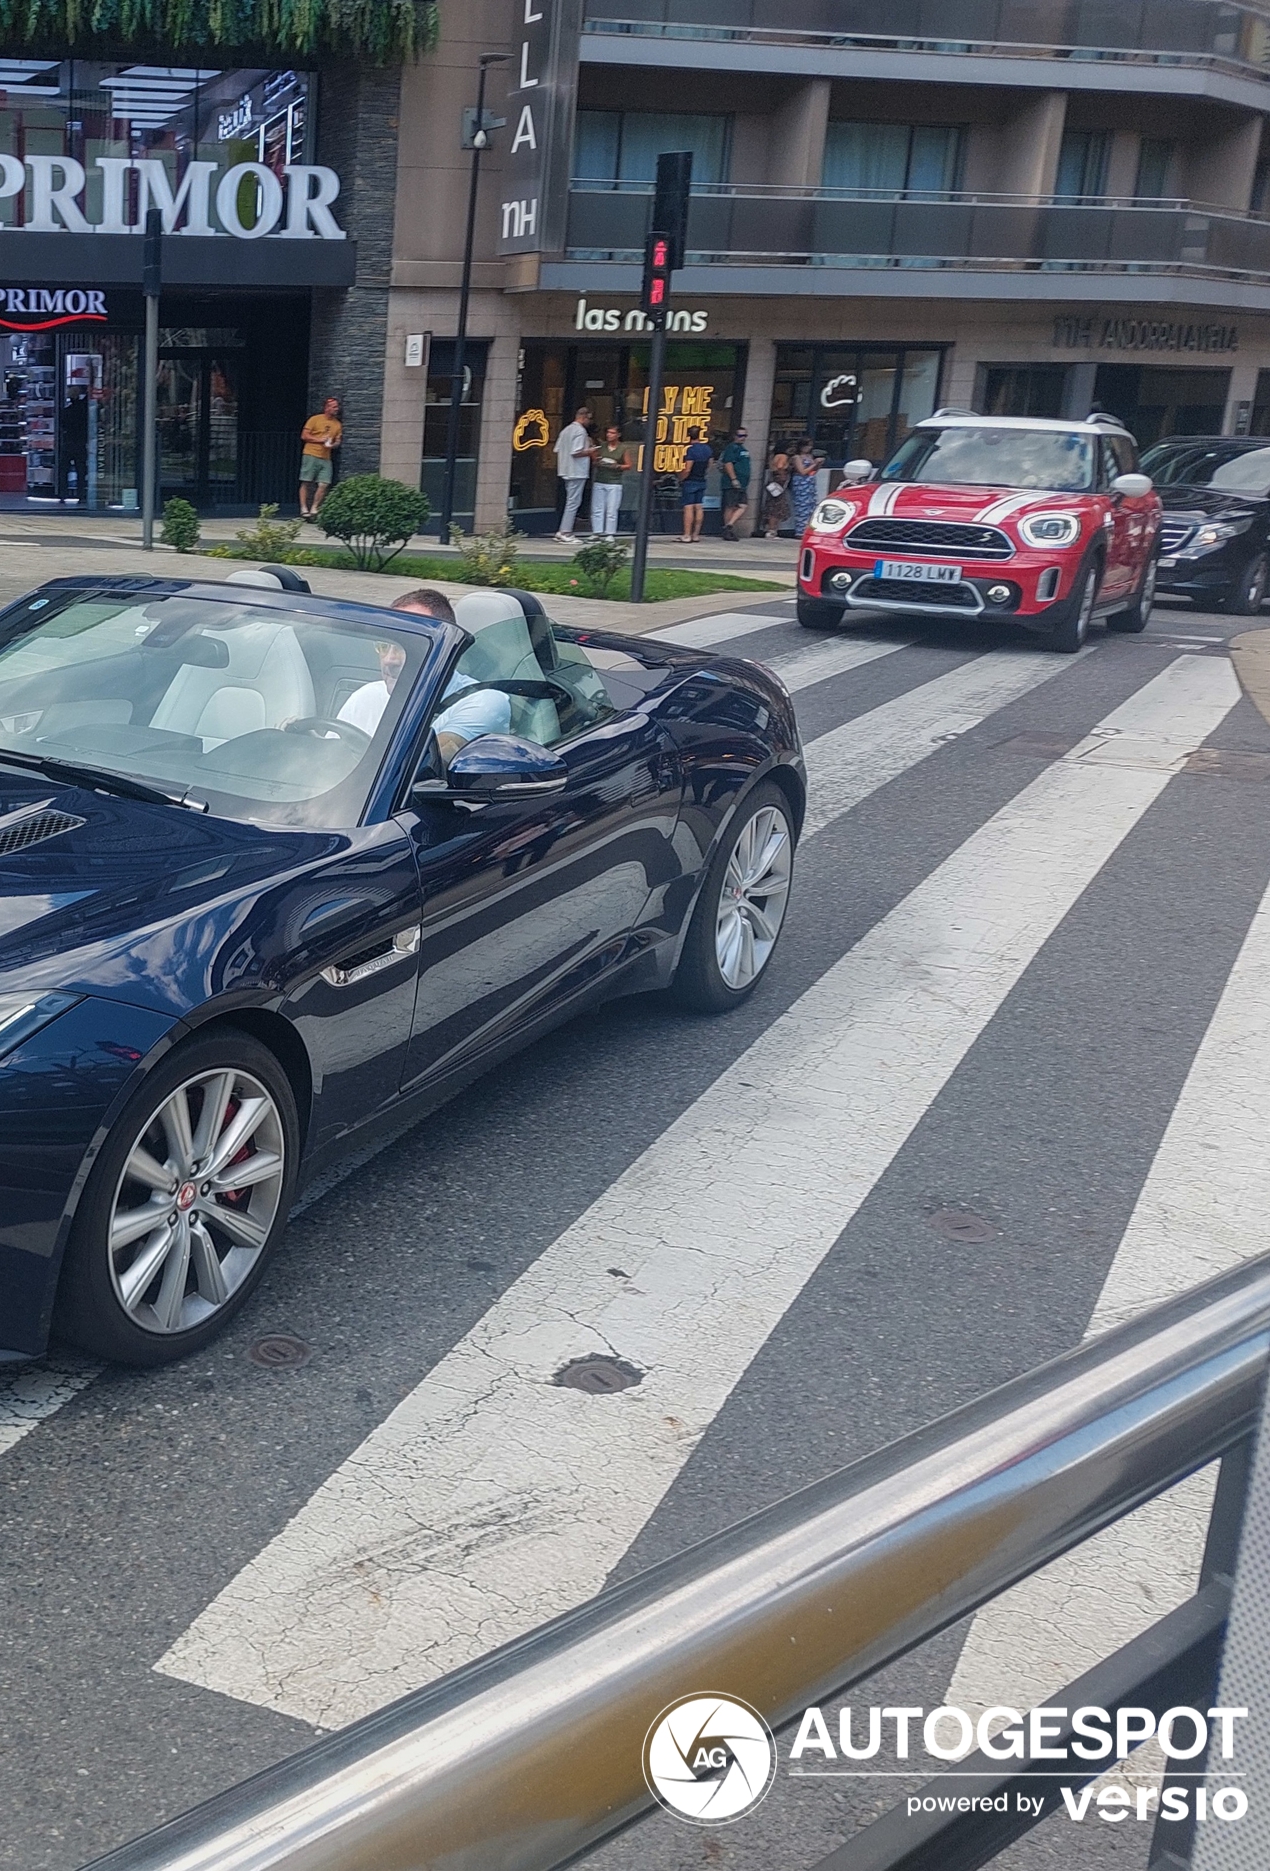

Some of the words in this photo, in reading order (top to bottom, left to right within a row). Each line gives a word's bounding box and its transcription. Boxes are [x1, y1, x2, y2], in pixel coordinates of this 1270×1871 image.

[576, 299, 622, 331] las
[682, 386, 714, 414] ME
[97, 428, 105, 479] GIVENCHY
[888, 564, 923, 578] 1128
